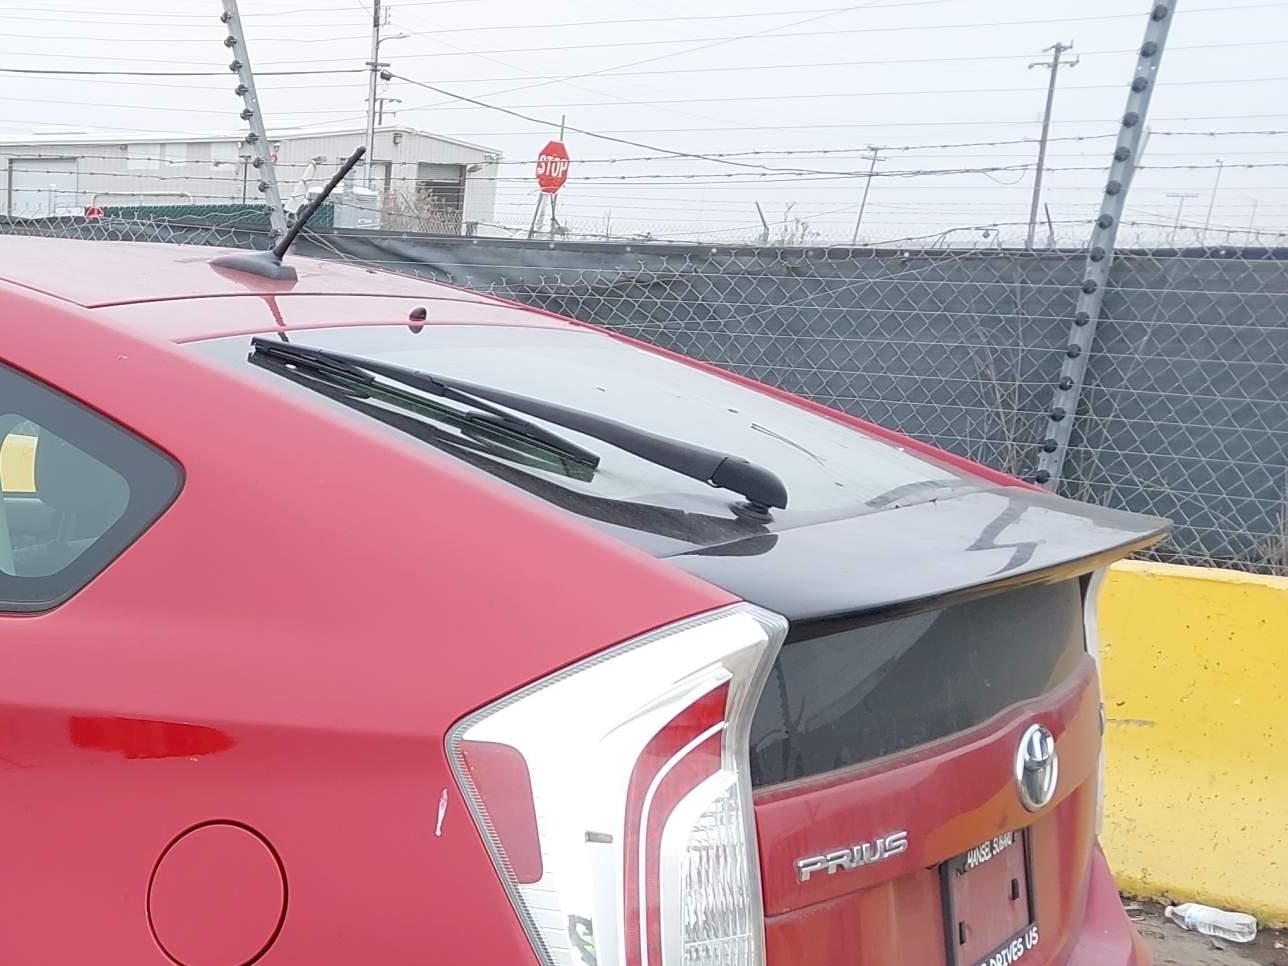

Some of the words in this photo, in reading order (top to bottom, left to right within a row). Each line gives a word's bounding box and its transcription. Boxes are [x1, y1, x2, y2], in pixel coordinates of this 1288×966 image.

[536, 154, 569, 177] STOP
[796, 831, 909, 882] PRIUS
[1025, 926, 1039, 949] US
